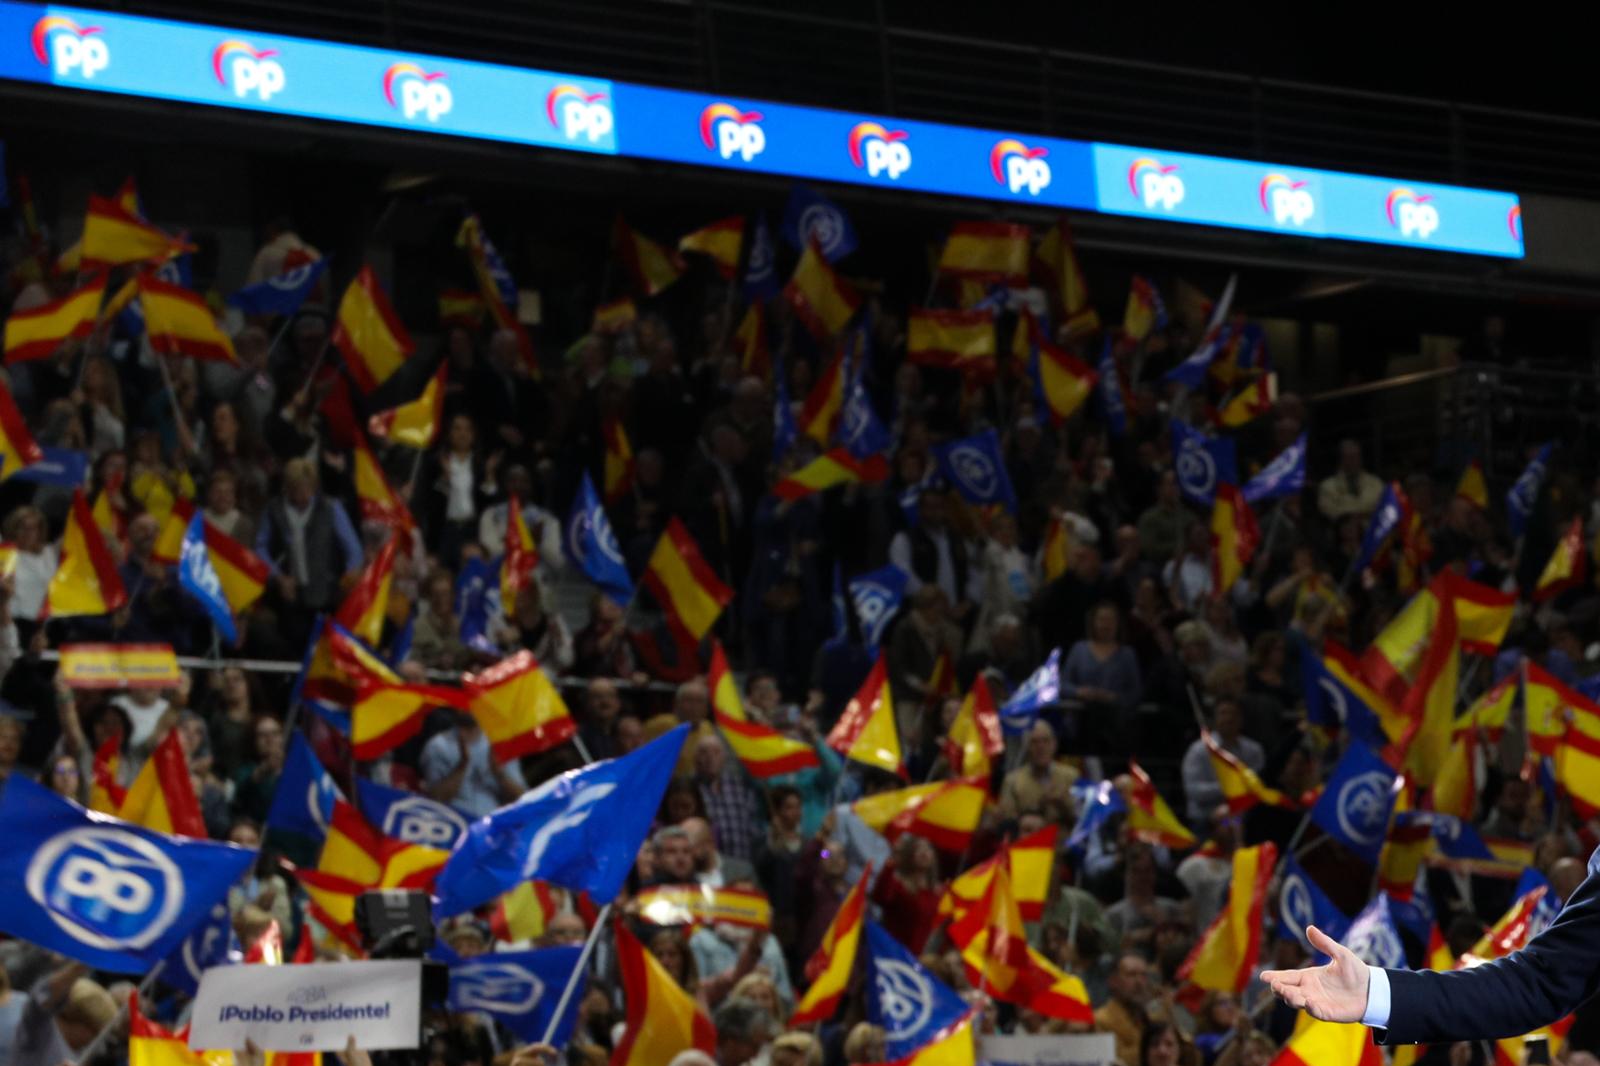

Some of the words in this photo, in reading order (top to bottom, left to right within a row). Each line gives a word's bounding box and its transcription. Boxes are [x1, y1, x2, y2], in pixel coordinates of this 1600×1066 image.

[53, 31, 109, 78] pp
[232, 56, 286, 101] pp
[401, 78, 453, 121] pp
[563, 99, 613, 142] pp
[718, 119, 765, 162] pp
[866, 138, 912, 180] pp
[1007, 156, 1051, 196] pp
[1142, 171, 1184, 210] pp
[1273, 186, 1315, 226] pp
[1399, 202, 1439, 240] pp
[219, 1004, 284, 1023] ¡Pablo
[288, 1002, 391, 1023] Presidente!
